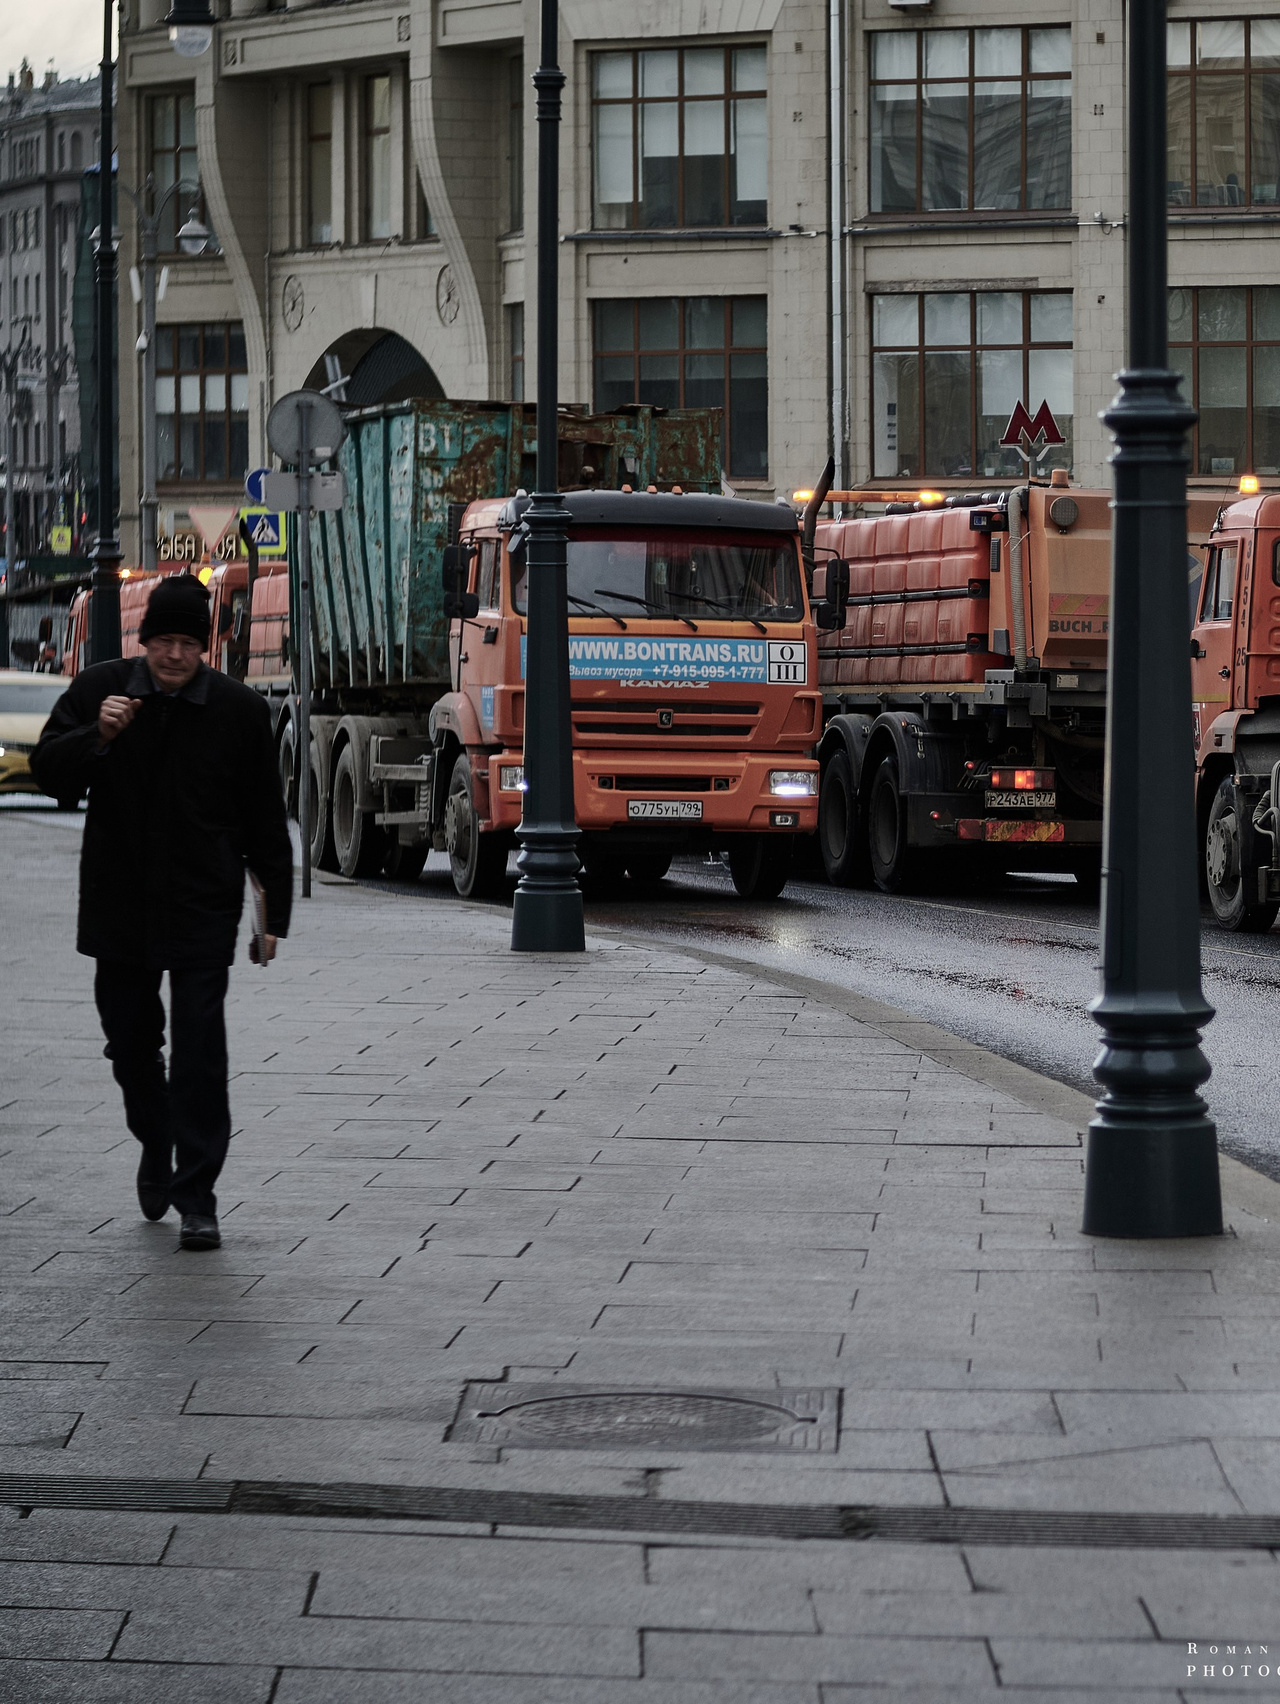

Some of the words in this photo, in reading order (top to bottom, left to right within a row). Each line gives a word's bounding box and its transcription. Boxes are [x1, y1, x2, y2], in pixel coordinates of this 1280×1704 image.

[156, 533, 196, 561] ЫБА
[201, 533, 237, 561] ОЯ
[1049, 619, 1109, 633] BUCH
[568, 641, 764, 663] WWW.BONTRANS.RU
[568, 664, 602, 676] Вывоз
[604, 667, 643, 678] мусора
[652, 664, 765, 679] +7-915-095-1-777
[620, 679, 710, 689] KAMAZ
